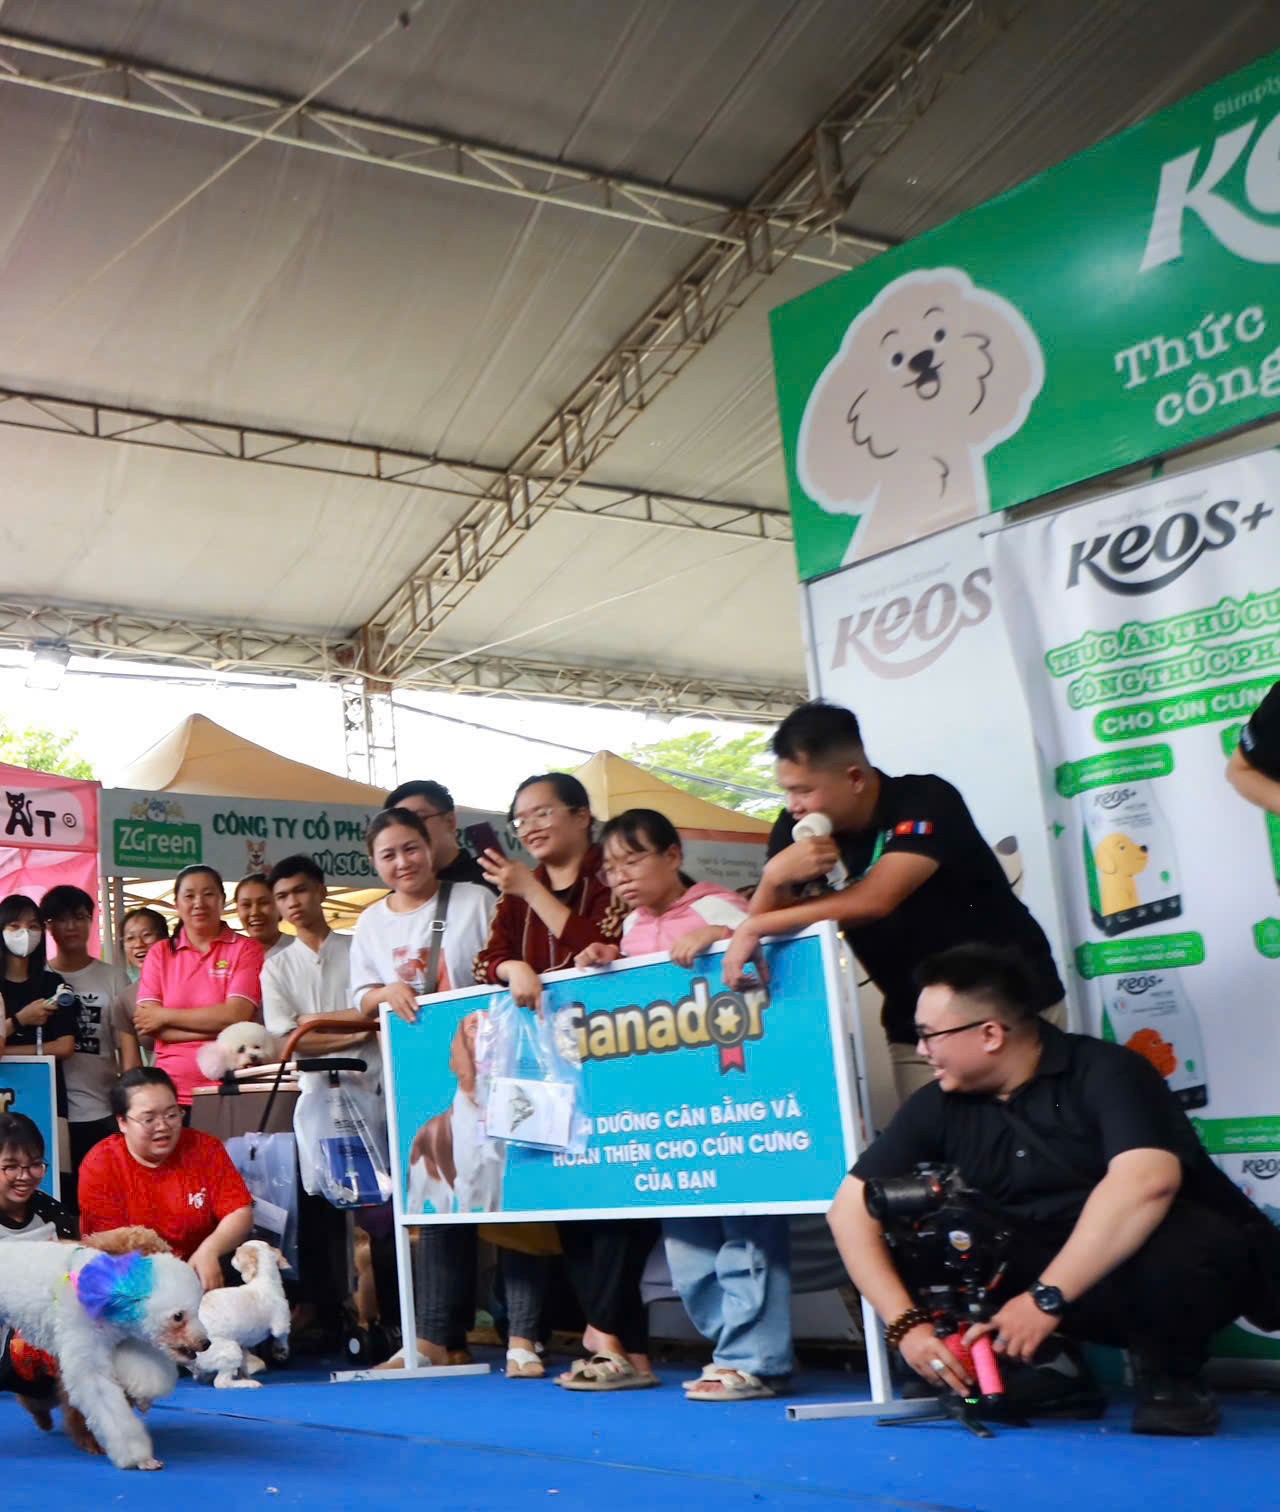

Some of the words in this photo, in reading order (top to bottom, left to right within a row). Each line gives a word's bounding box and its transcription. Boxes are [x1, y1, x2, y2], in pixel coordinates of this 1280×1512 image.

[1114, 305, 1266, 390] Thức
[1232, 636, 1280, 667] PH
[1102, 712, 1155, 734] CHO
[118, 826, 197, 855] ZGreen
[212, 810, 268, 838] CÔNG
[272, 817, 297, 839] TY
[335, 817, 368, 842] PH
[598, 1108, 660, 1135] DƯỠNG
[665, 1103, 706, 1128] CÂN
[711, 1096, 768, 1124] BẰNG
[771, 1091, 802, 1118] VÀ
[606, 1139, 651, 1167] THIỆN
[655, 1138, 697, 1160] CHO
[702, 1131, 744, 1158] CÚN
[749, 1129, 809, 1154] CƯNG
[634, 1166, 673, 1192] CỦA
[678, 1168, 717, 1195] BẠN
